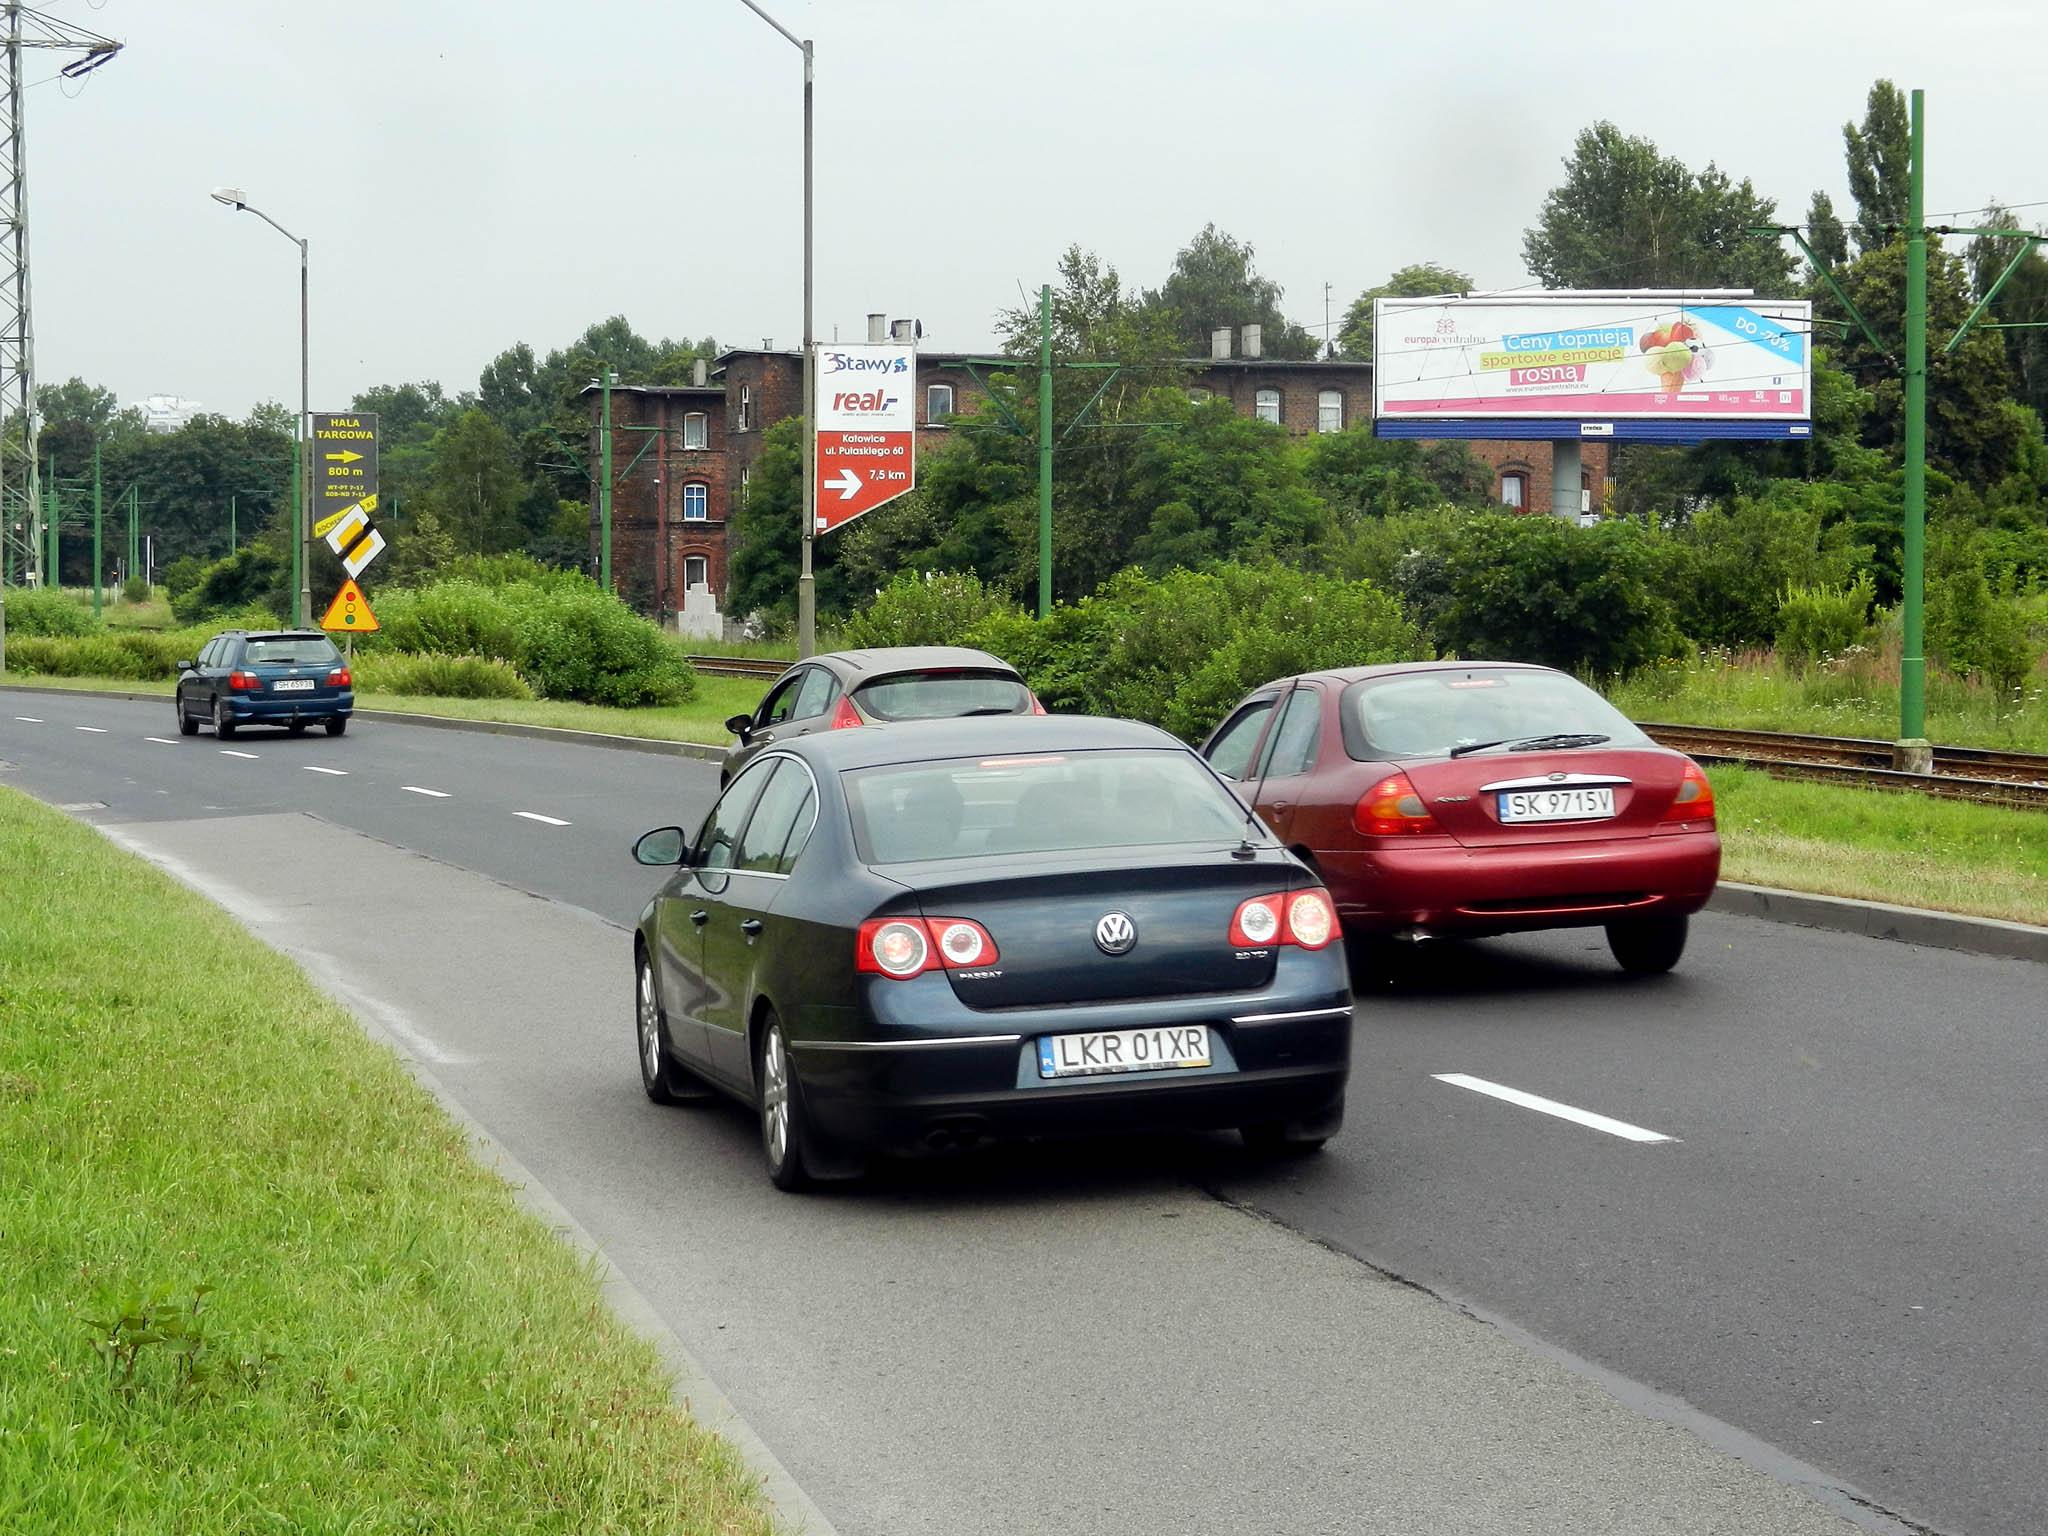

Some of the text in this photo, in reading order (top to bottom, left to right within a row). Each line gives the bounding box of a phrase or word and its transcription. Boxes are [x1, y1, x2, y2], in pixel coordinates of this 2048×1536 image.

[1735, 316, 1758, 335] DO
[1507, 329, 1631, 351] Ceny topnieją
[1482, 348, 1622, 369] sportowe emocje
[1517, 365, 1579, 384] rosną
[330, 418, 361, 428] HALA
[317, 430, 374, 440] TARGOWA
[842, 434, 886, 443] Katowice
[825, 447, 836, 455] ul.
[892, 446, 904, 455] 60
[328, 467, 349, 476] 800
[869, 469, 906, 481] 7,5 km
[1514, 791, 1611, 816] SK 9715V
[1060, 1028, 1204, 1067] LKR 01XR
